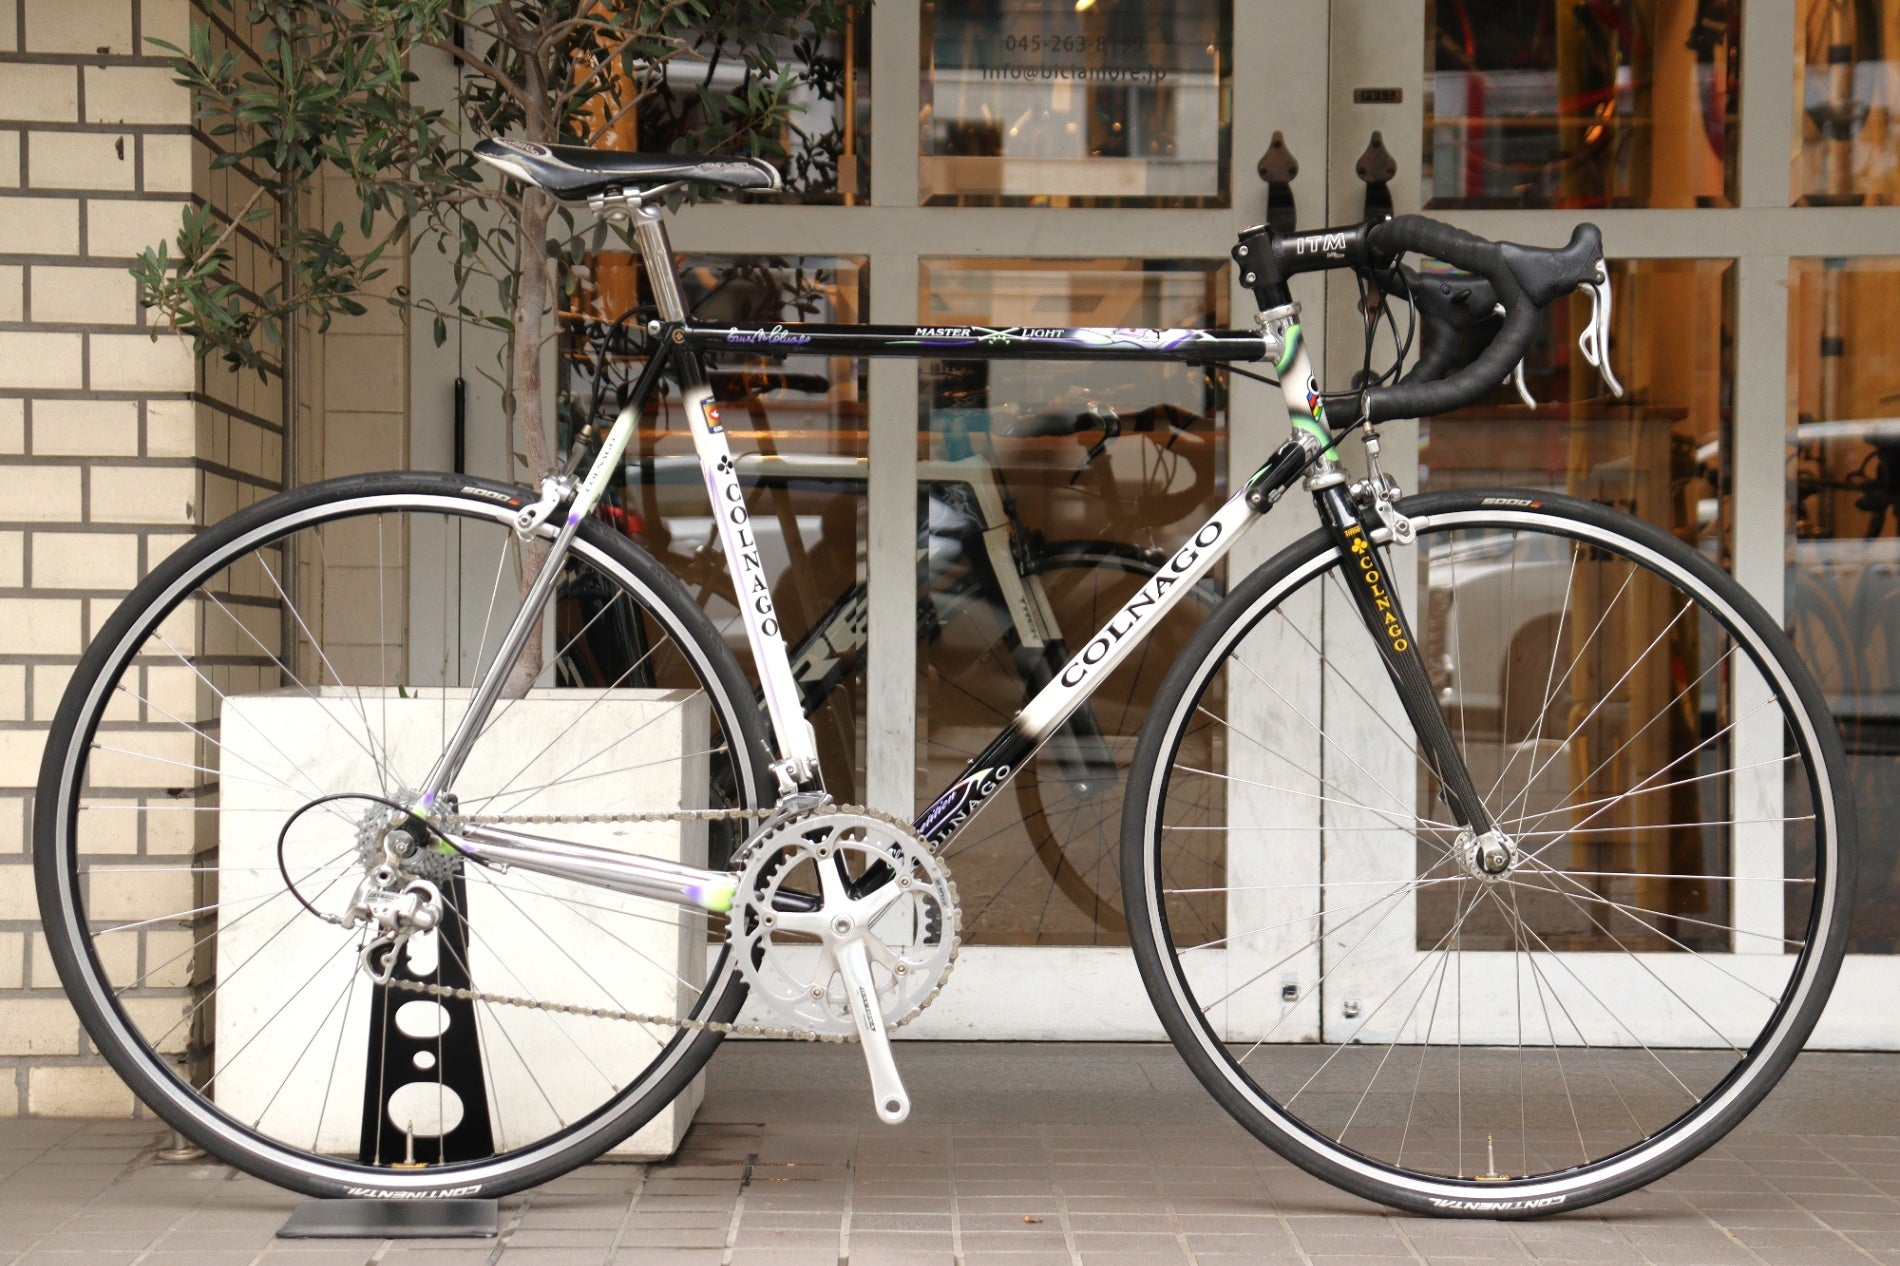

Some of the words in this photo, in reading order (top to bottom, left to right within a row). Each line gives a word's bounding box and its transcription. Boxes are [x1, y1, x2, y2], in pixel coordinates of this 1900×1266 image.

[1297, 232, 1346, 255] ITM
[914, 327, 971, 337] MASTER
[1022, 328, 1065, 338] LIGHT
[726, 482, 779, 637] COLNAGO
[1061, 521, 1222, 688] COLNAGO
[1359, 555, 1408, 652] COLNAGO
[1429, 1195, 1566, 1210] CONTINENTAL
